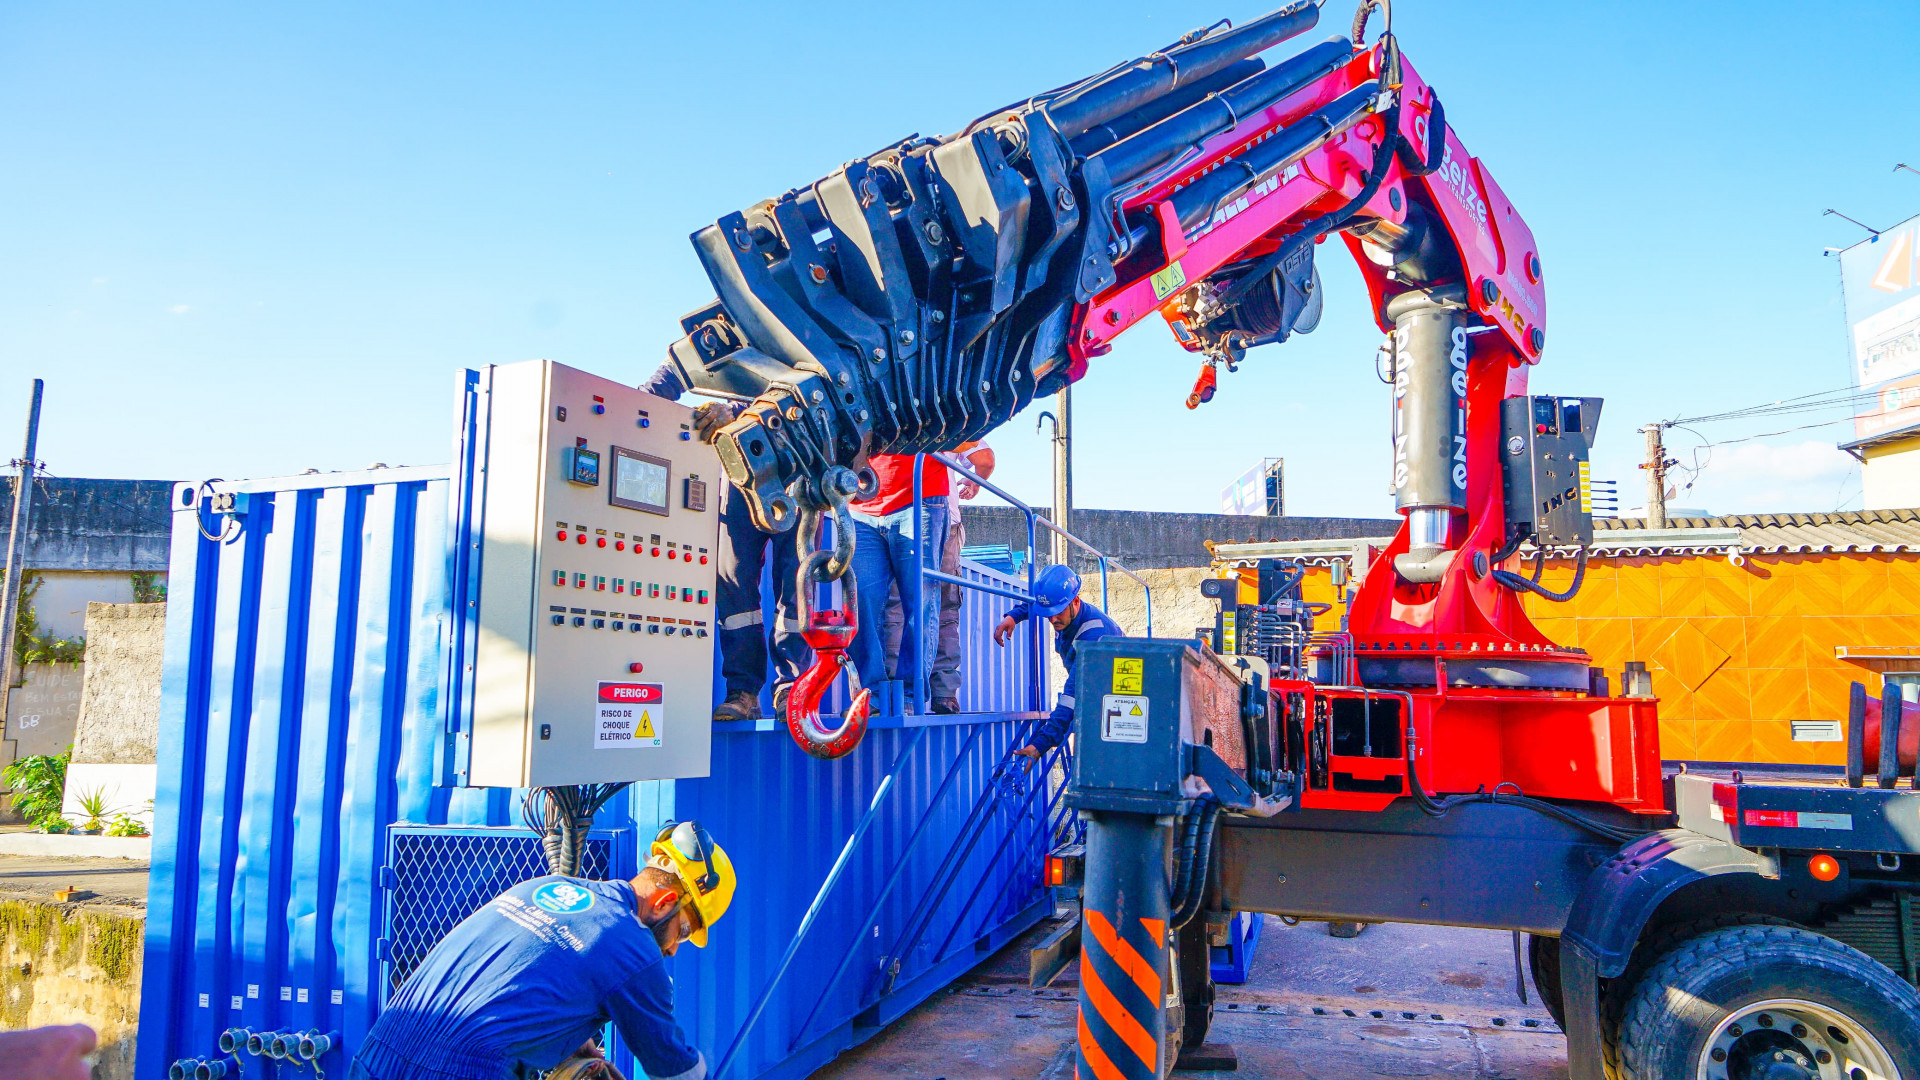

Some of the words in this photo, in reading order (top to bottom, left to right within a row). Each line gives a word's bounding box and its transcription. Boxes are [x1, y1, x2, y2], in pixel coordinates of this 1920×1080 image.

[1448, 181, 1486, 237] TRANSPORTES
[613, 687, 648, 699] PERIGO
[601, 710, 622, 718] RISCO
[623, 710, 632, 718] DE
[602, 721, 630, 730] CHOQUE
[600, 731, 632, 741] ELÉTRICO
[556, 925, 585, 953] Carreta
